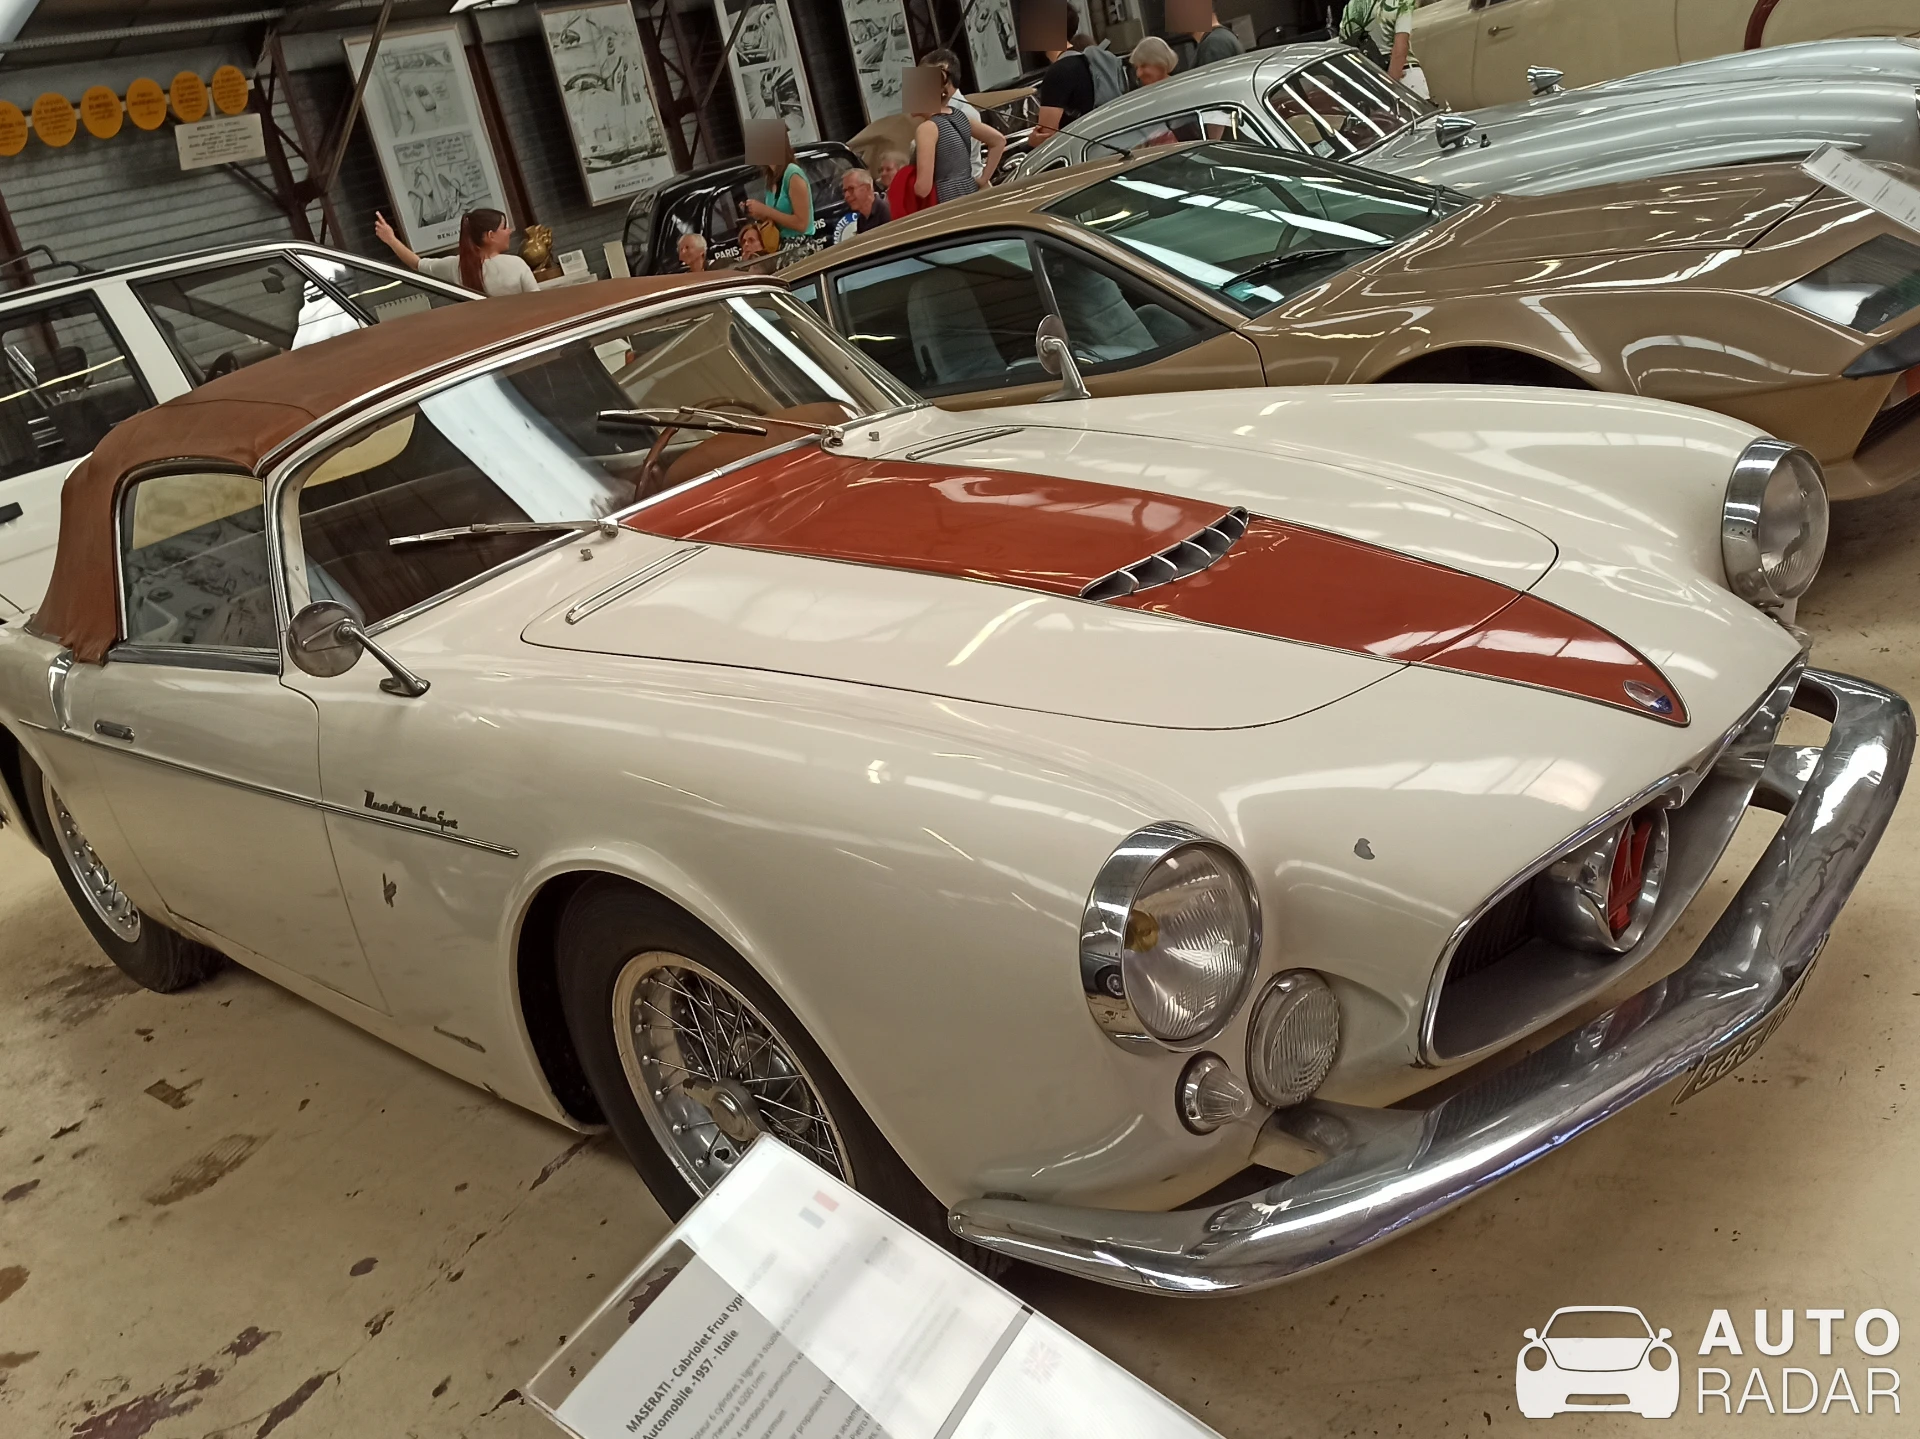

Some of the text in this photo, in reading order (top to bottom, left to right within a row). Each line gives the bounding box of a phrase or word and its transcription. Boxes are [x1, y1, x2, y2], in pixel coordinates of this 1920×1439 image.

[437, 230, 461, 240] BENJA
[713, 1330, 738, 1355] Italie
[625, 1381, 672, 1433] MASERATI
[672, 1333, 712, 1377] Cabriolet
[706, 1312, 730, 1334] Frua
